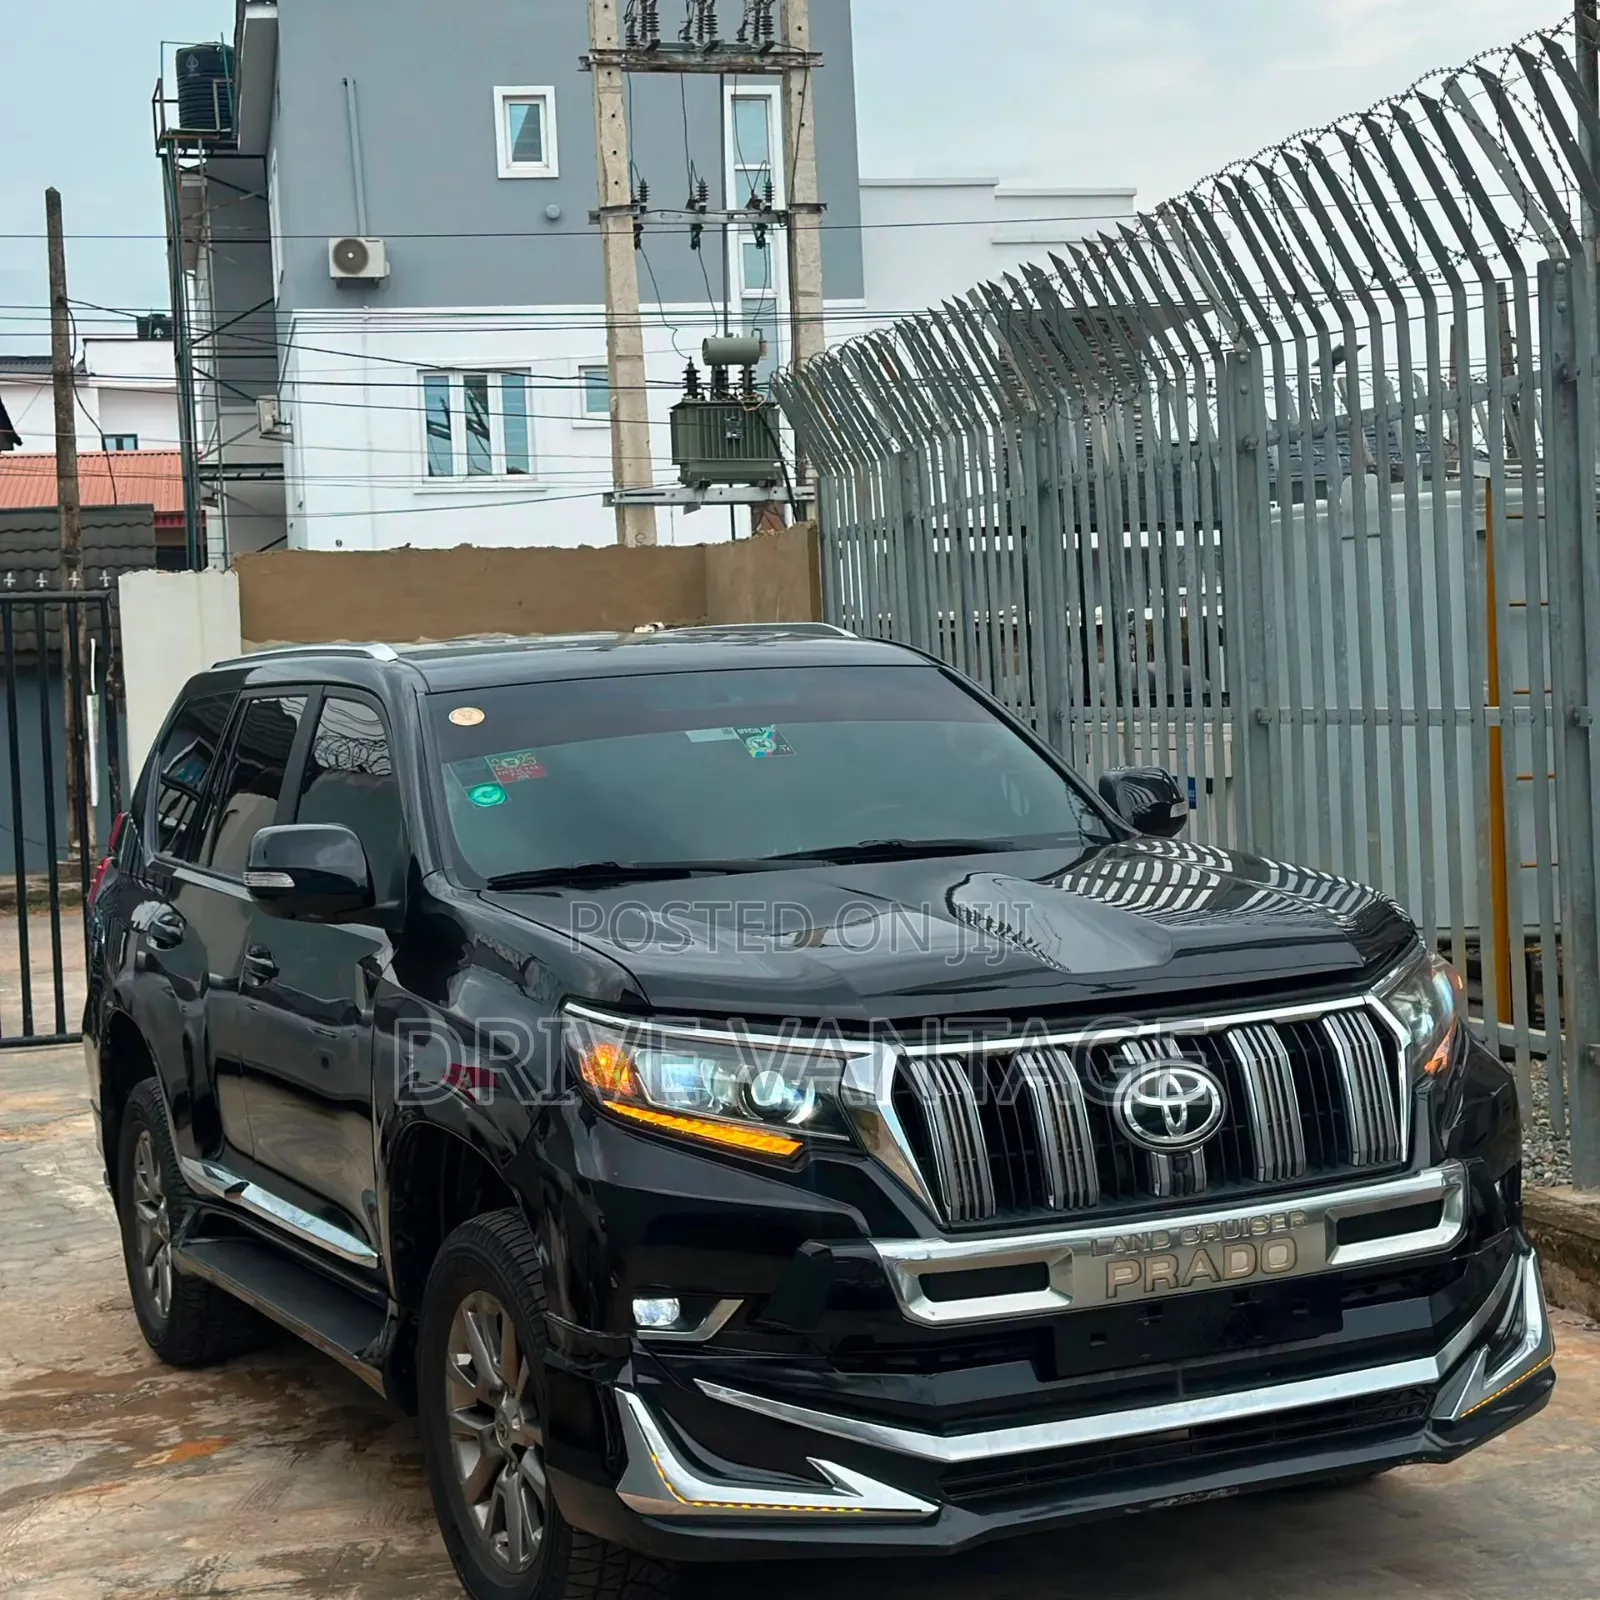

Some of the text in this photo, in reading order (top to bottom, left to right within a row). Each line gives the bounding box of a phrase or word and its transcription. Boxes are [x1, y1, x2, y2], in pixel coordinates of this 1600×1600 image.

[1090, 1210, 1309, 1257] LAND CRUISER
[1105, 1236, 1298, 1299] PRADO
